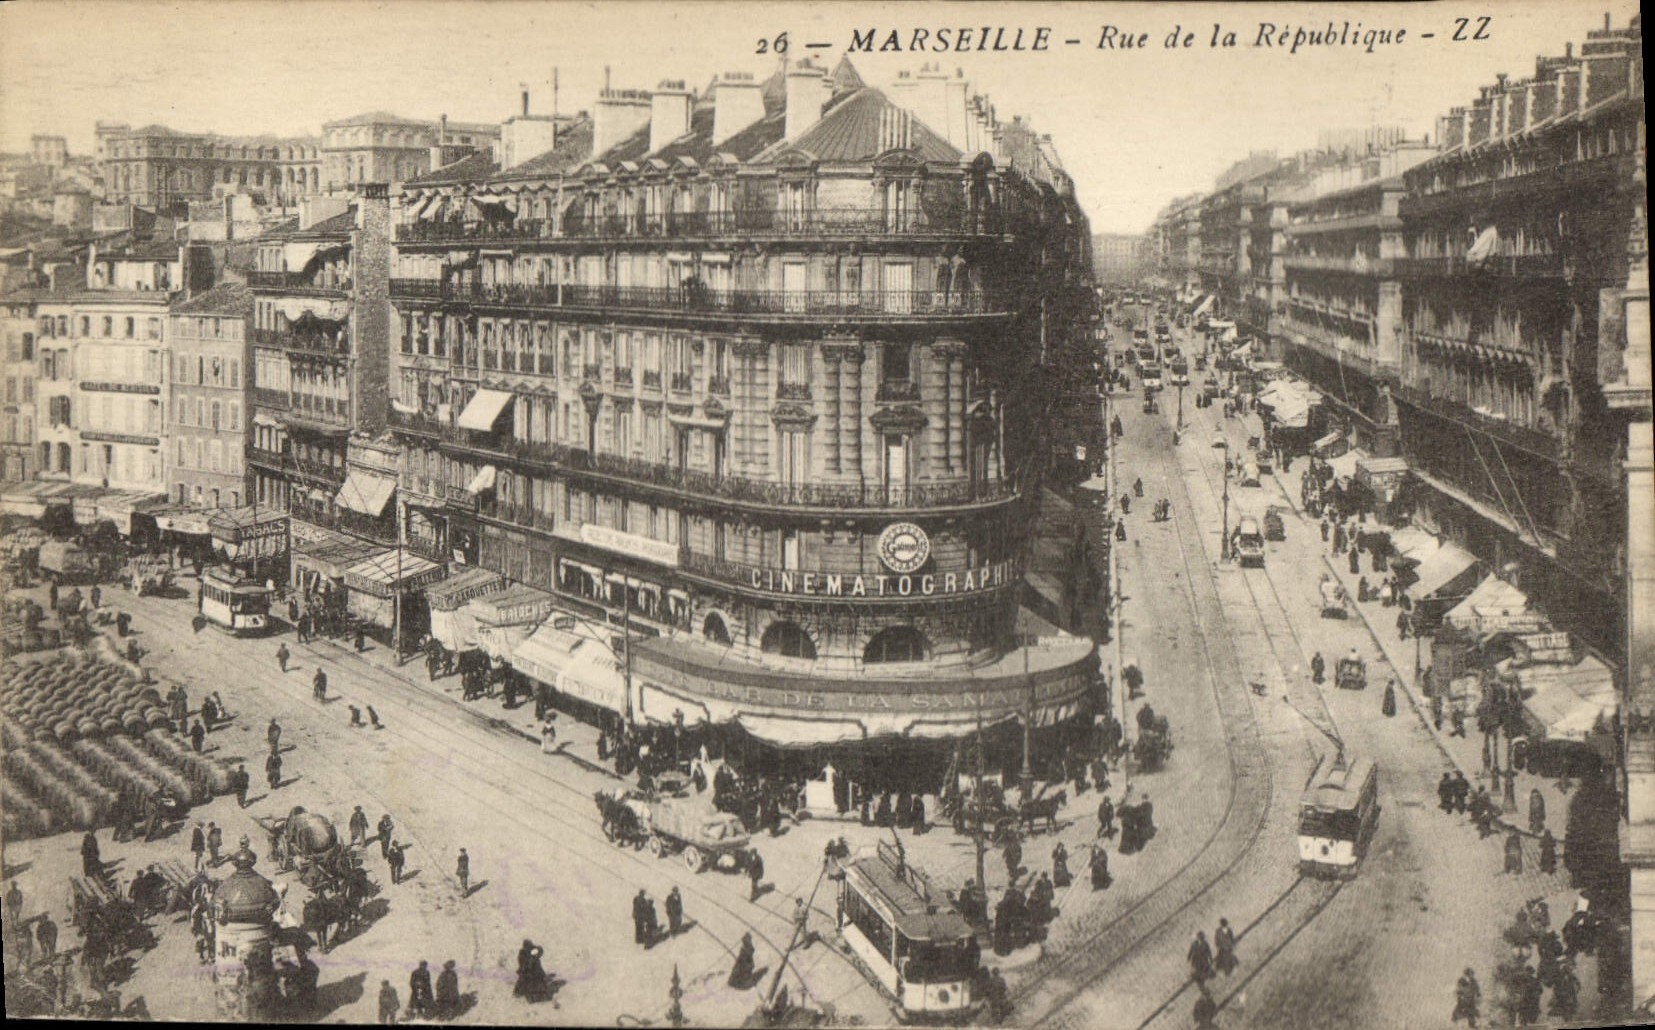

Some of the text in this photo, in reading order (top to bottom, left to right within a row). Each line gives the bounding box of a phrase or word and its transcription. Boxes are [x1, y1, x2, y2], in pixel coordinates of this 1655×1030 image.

[707, 681, 762, 701] BAR
[784, 691, 824, 706] DE
[847, 693, 890, 708] LA
